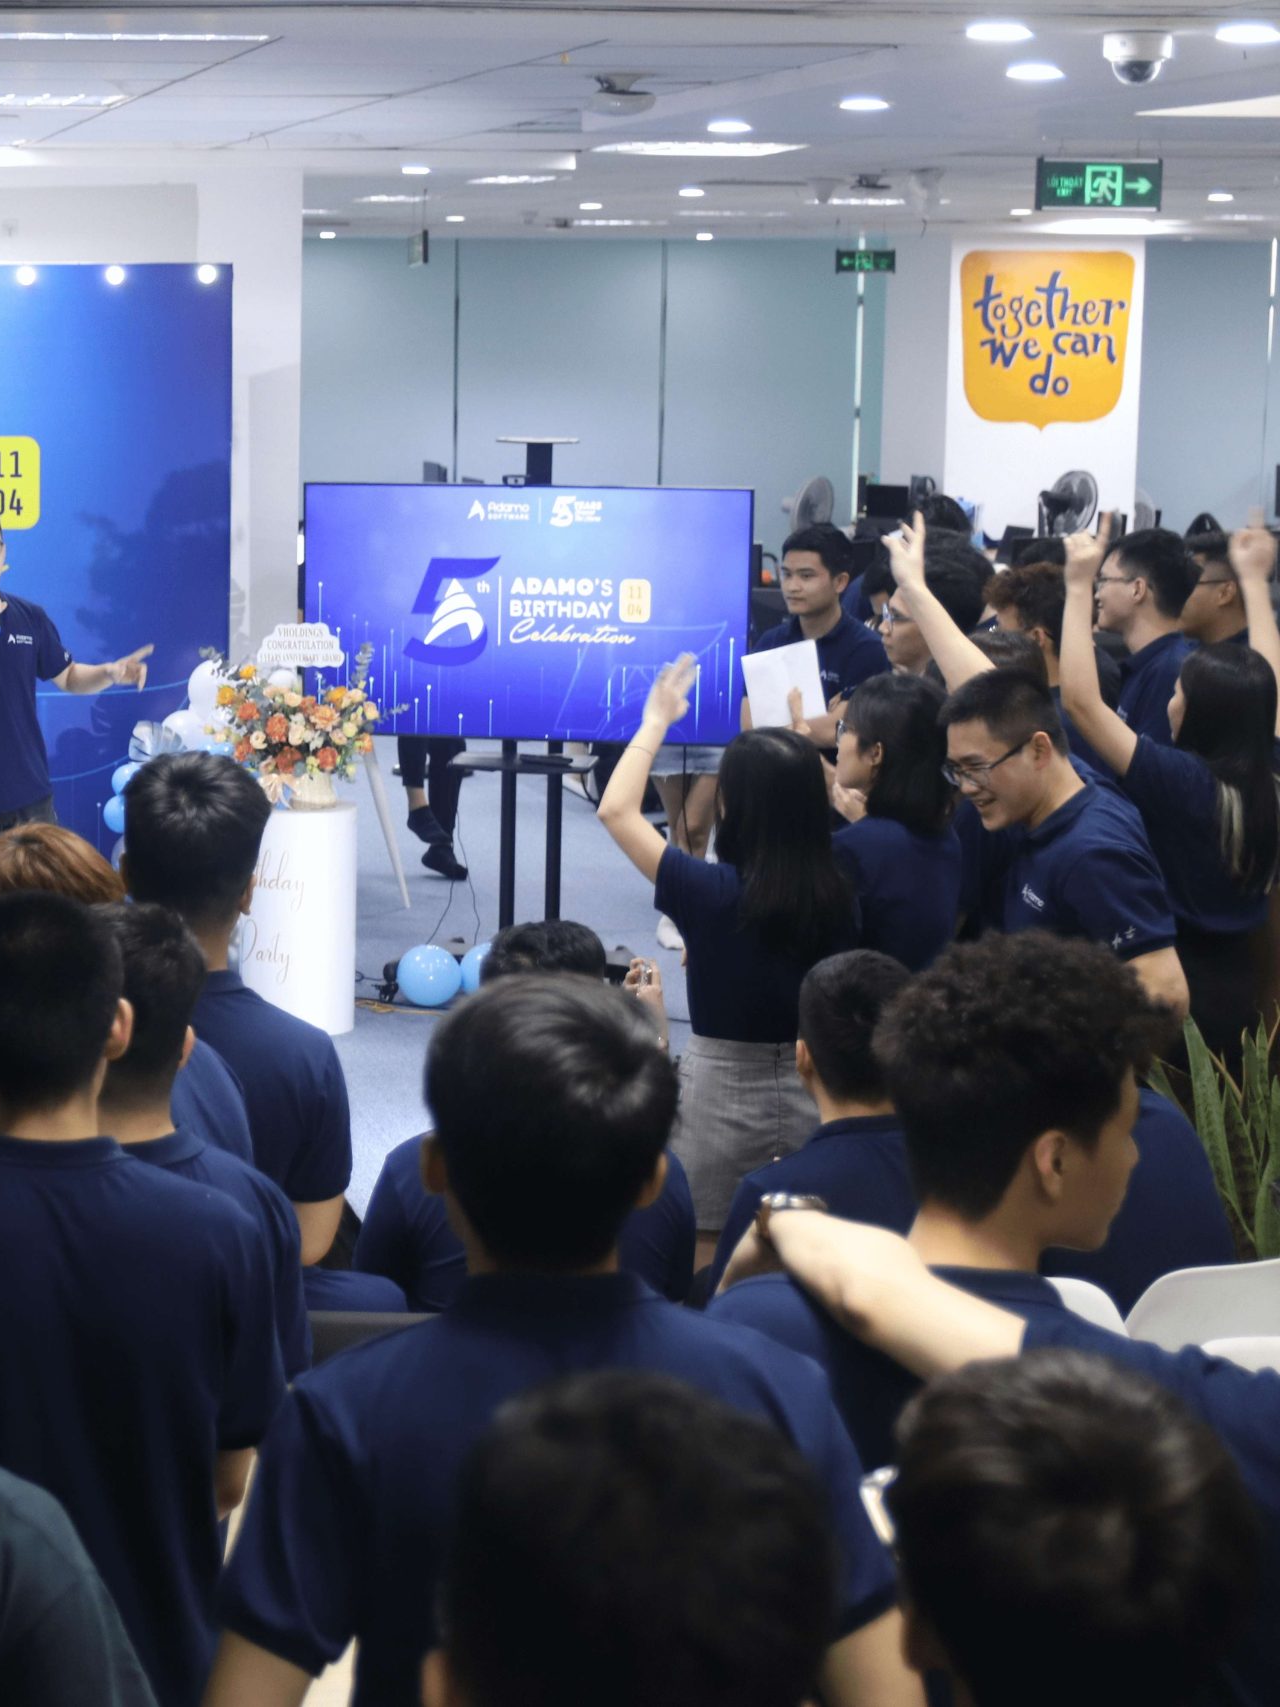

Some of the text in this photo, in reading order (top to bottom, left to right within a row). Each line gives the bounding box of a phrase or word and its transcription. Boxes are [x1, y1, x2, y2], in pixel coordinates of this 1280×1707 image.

[973, 271, 1126, 340] together
[980, 332, 1117, 368] we can
[1029, 354, 1069, 396] do
[488, 501, 530, 513] Adamo
[510, 577, 613, 597] ADAMO'S
[629, 586, 642, 599] 11
[509, 599, 613, 619] BIRTHDAY
[509, 617, 637, 644] Celebration
[267, 640, 334, 650] CONGRATULATION
